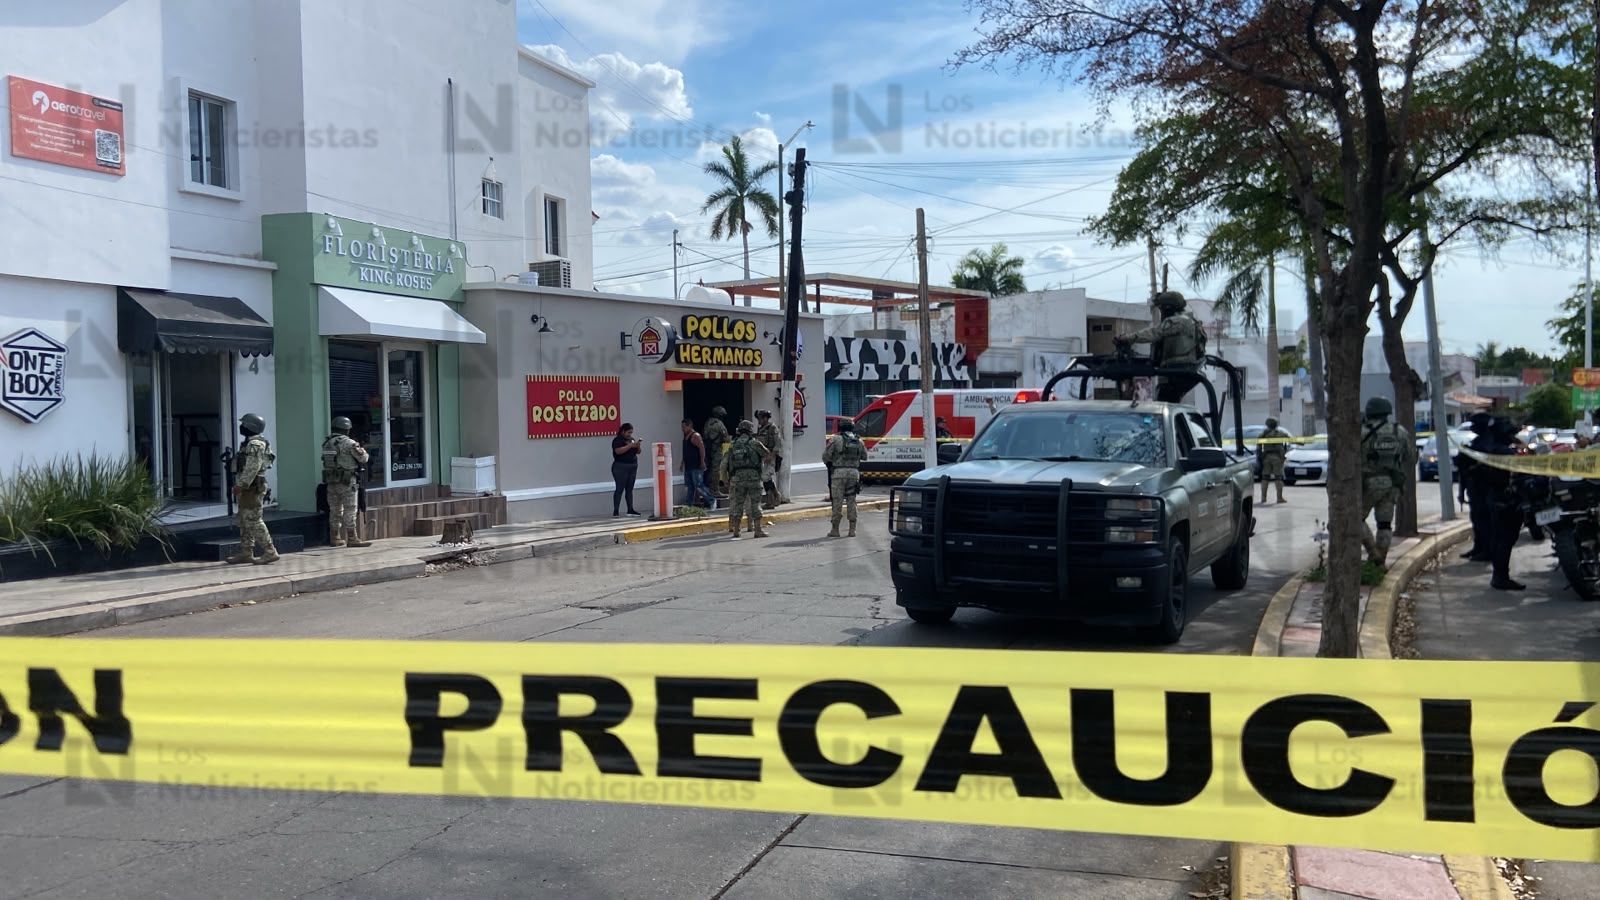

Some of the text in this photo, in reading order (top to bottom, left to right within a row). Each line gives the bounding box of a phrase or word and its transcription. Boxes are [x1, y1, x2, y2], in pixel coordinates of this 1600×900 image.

[51, 101, 106, 121] aerotravel
[323, 234, 455, 274] FLORISTERÍA
[360, 267, 433, 290] KING ROSES
[684, 315, 756, 342] POLLOS
[9, 350, 55, 375] ONE
[679, 342, 763, 366] HERMANOS
[249, 358, 259, 375] 4
[9, 372, 54, 396] BOX
[558, 389, 594, 402] POLLO
[964, 394, 1012, 404] AMBUNCIA
